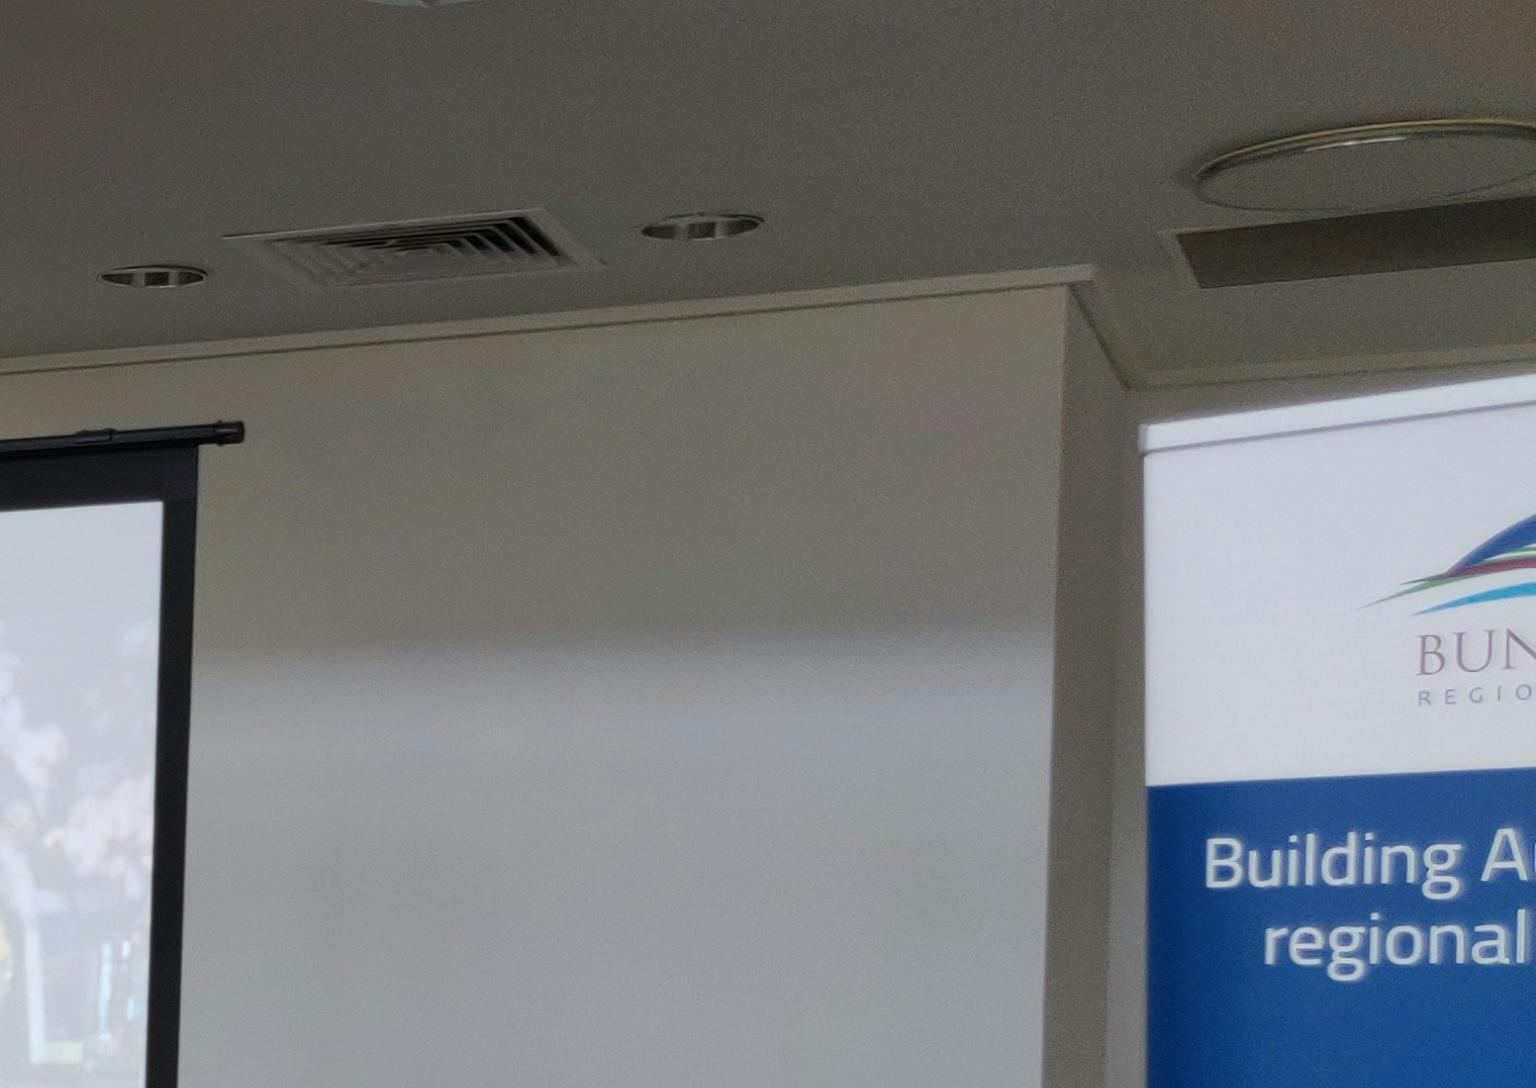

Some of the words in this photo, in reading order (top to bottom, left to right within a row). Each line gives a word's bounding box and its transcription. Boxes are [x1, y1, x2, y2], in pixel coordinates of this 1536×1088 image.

[1205, 831, 1462, 900] Building
[1480, 828, 1536, 882] A
[1264, 908, 1526, 981] regional
